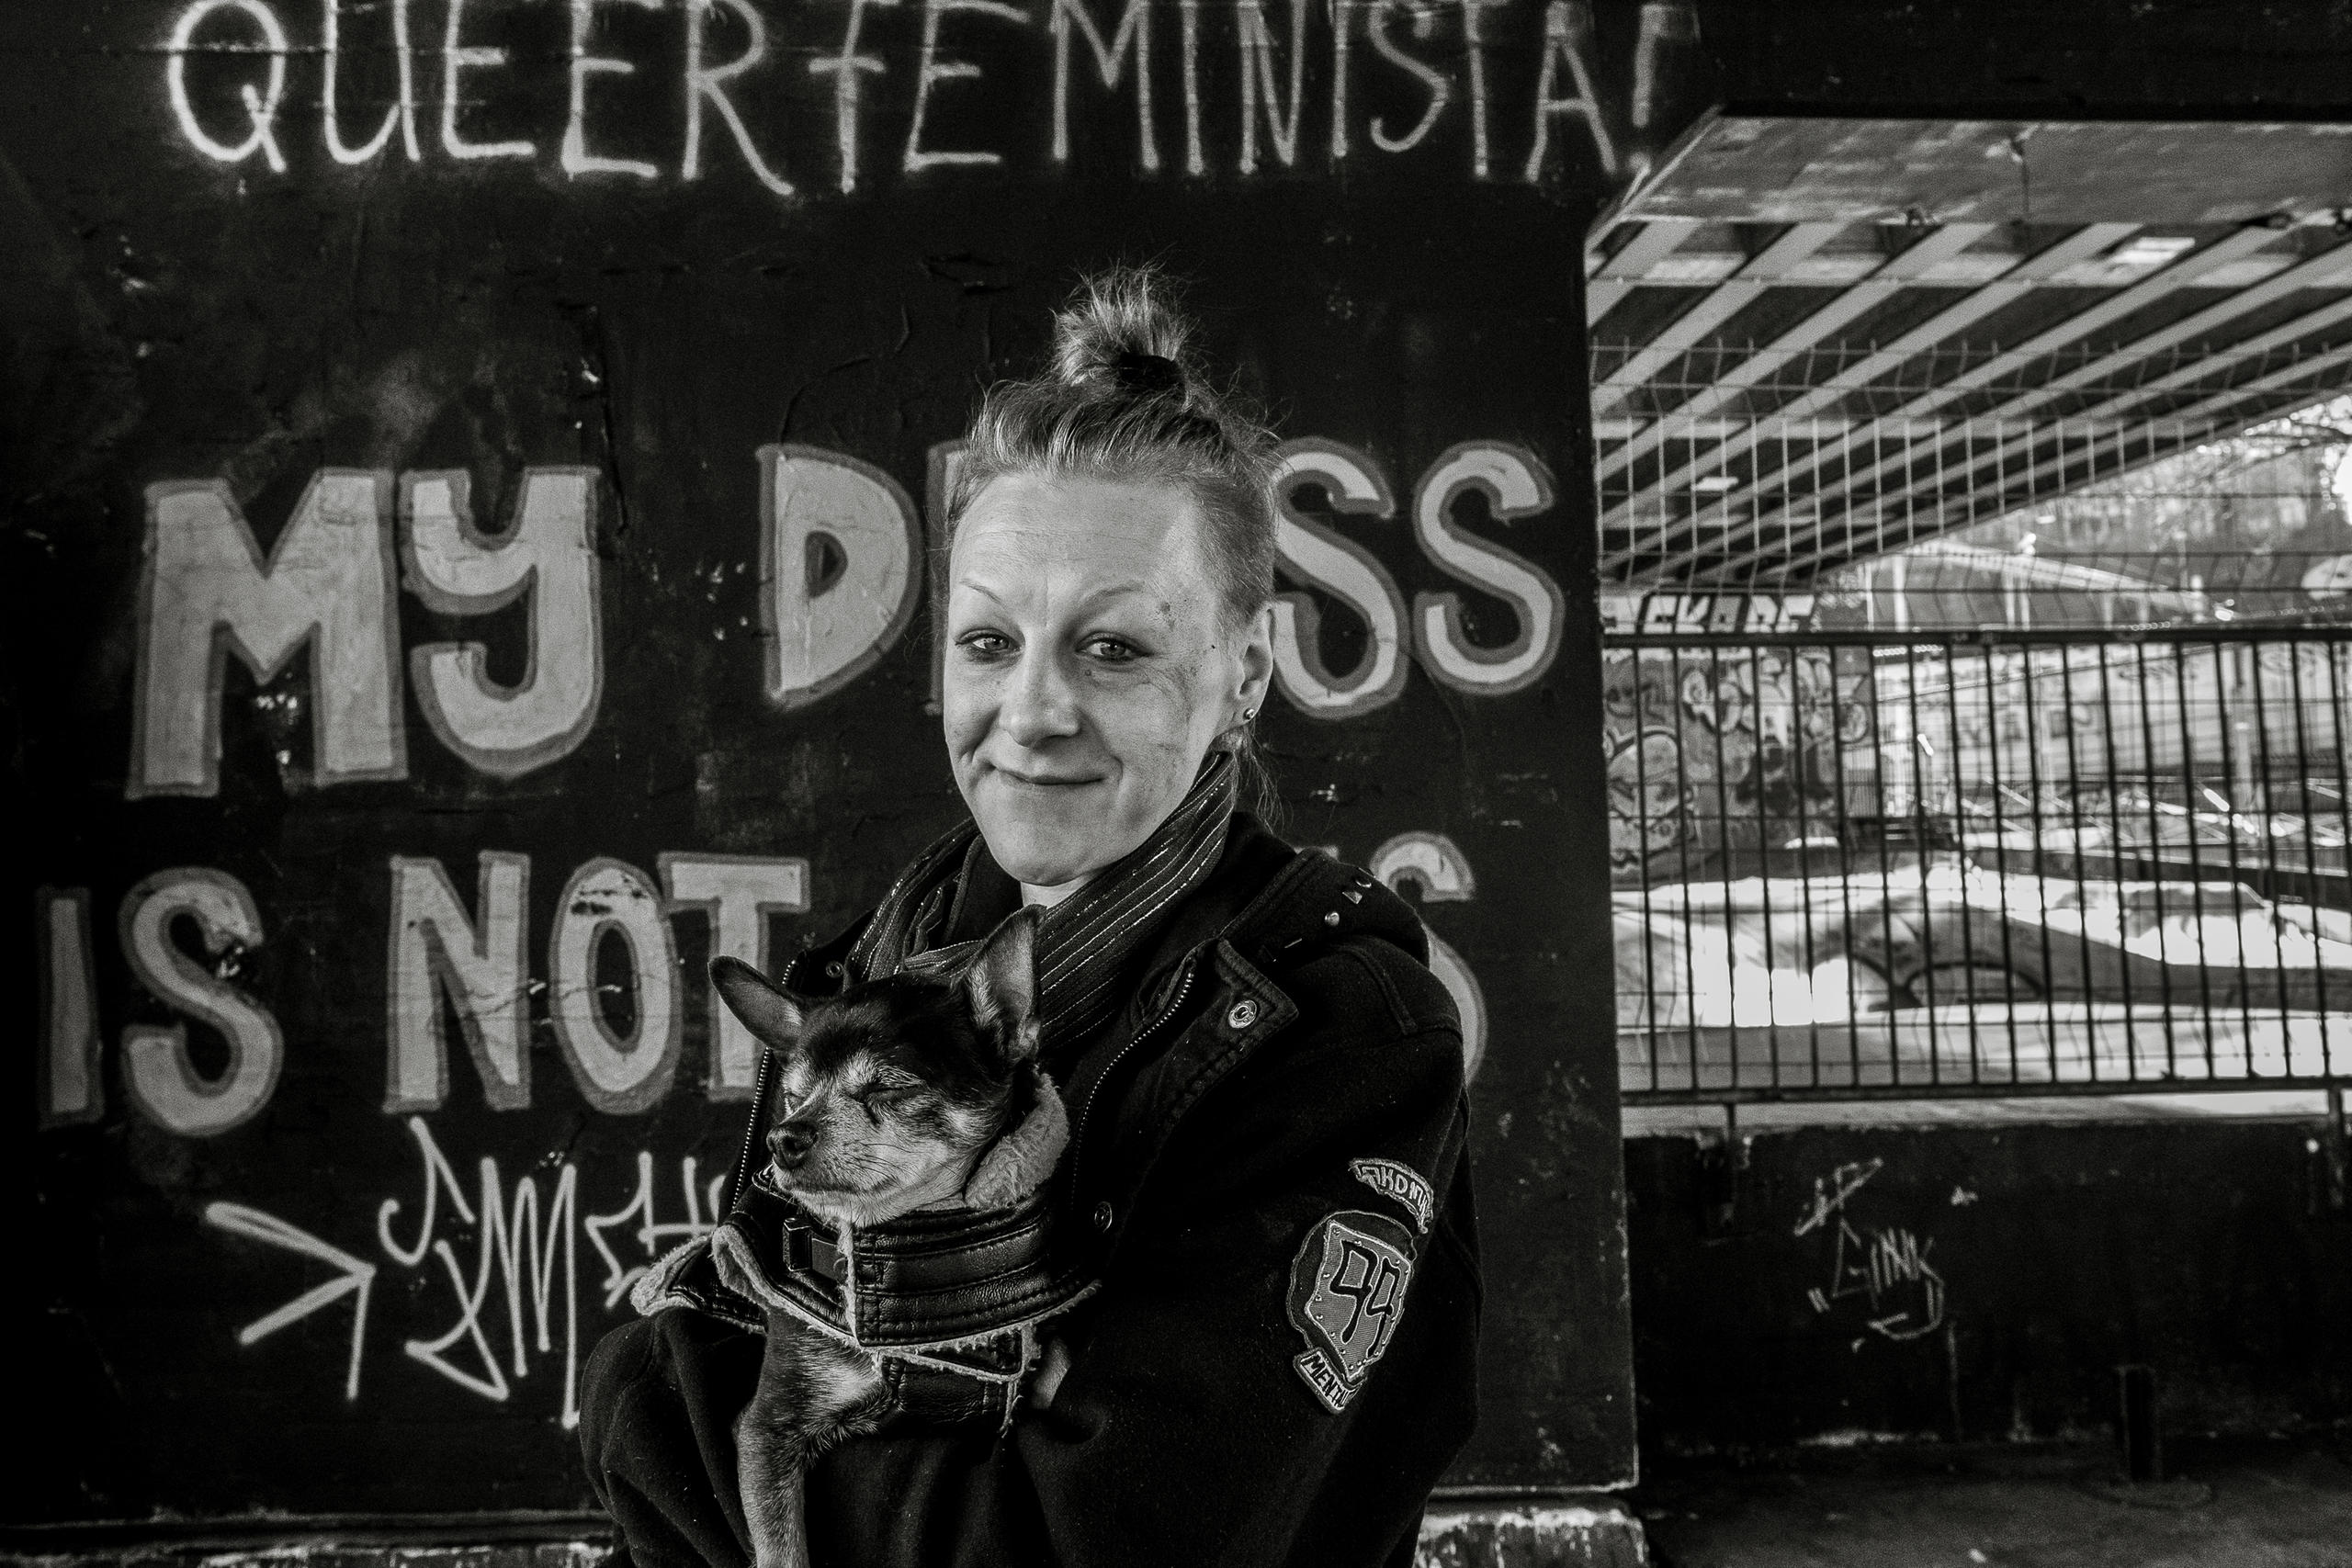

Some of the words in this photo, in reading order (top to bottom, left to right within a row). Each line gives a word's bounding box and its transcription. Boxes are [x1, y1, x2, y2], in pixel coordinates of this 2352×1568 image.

[127, 467, 604, 799] MY
[755, 443, 1564, 720] DSS
[37, 866, 285, 1136] IS
[383, 852, 809, 1113] NOT
